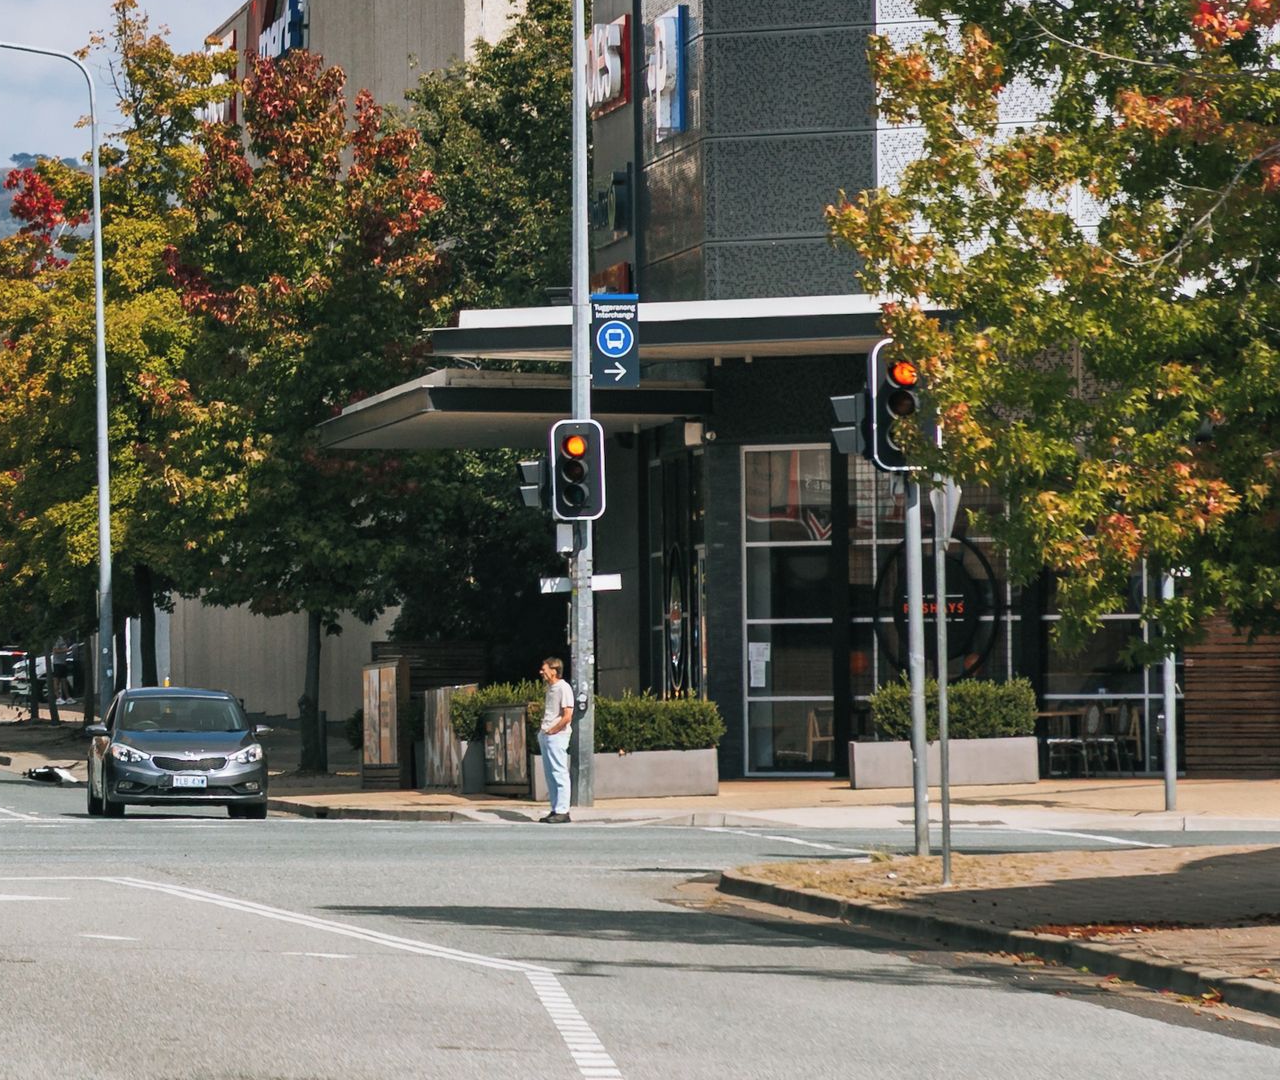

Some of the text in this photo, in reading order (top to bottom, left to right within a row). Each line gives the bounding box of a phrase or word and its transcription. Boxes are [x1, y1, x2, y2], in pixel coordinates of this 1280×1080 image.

[593, 303, 636, 312] Tuggeranong
[595, 312, 635, 320] Interchange
[903, 602, 965, 615] RSHYS
